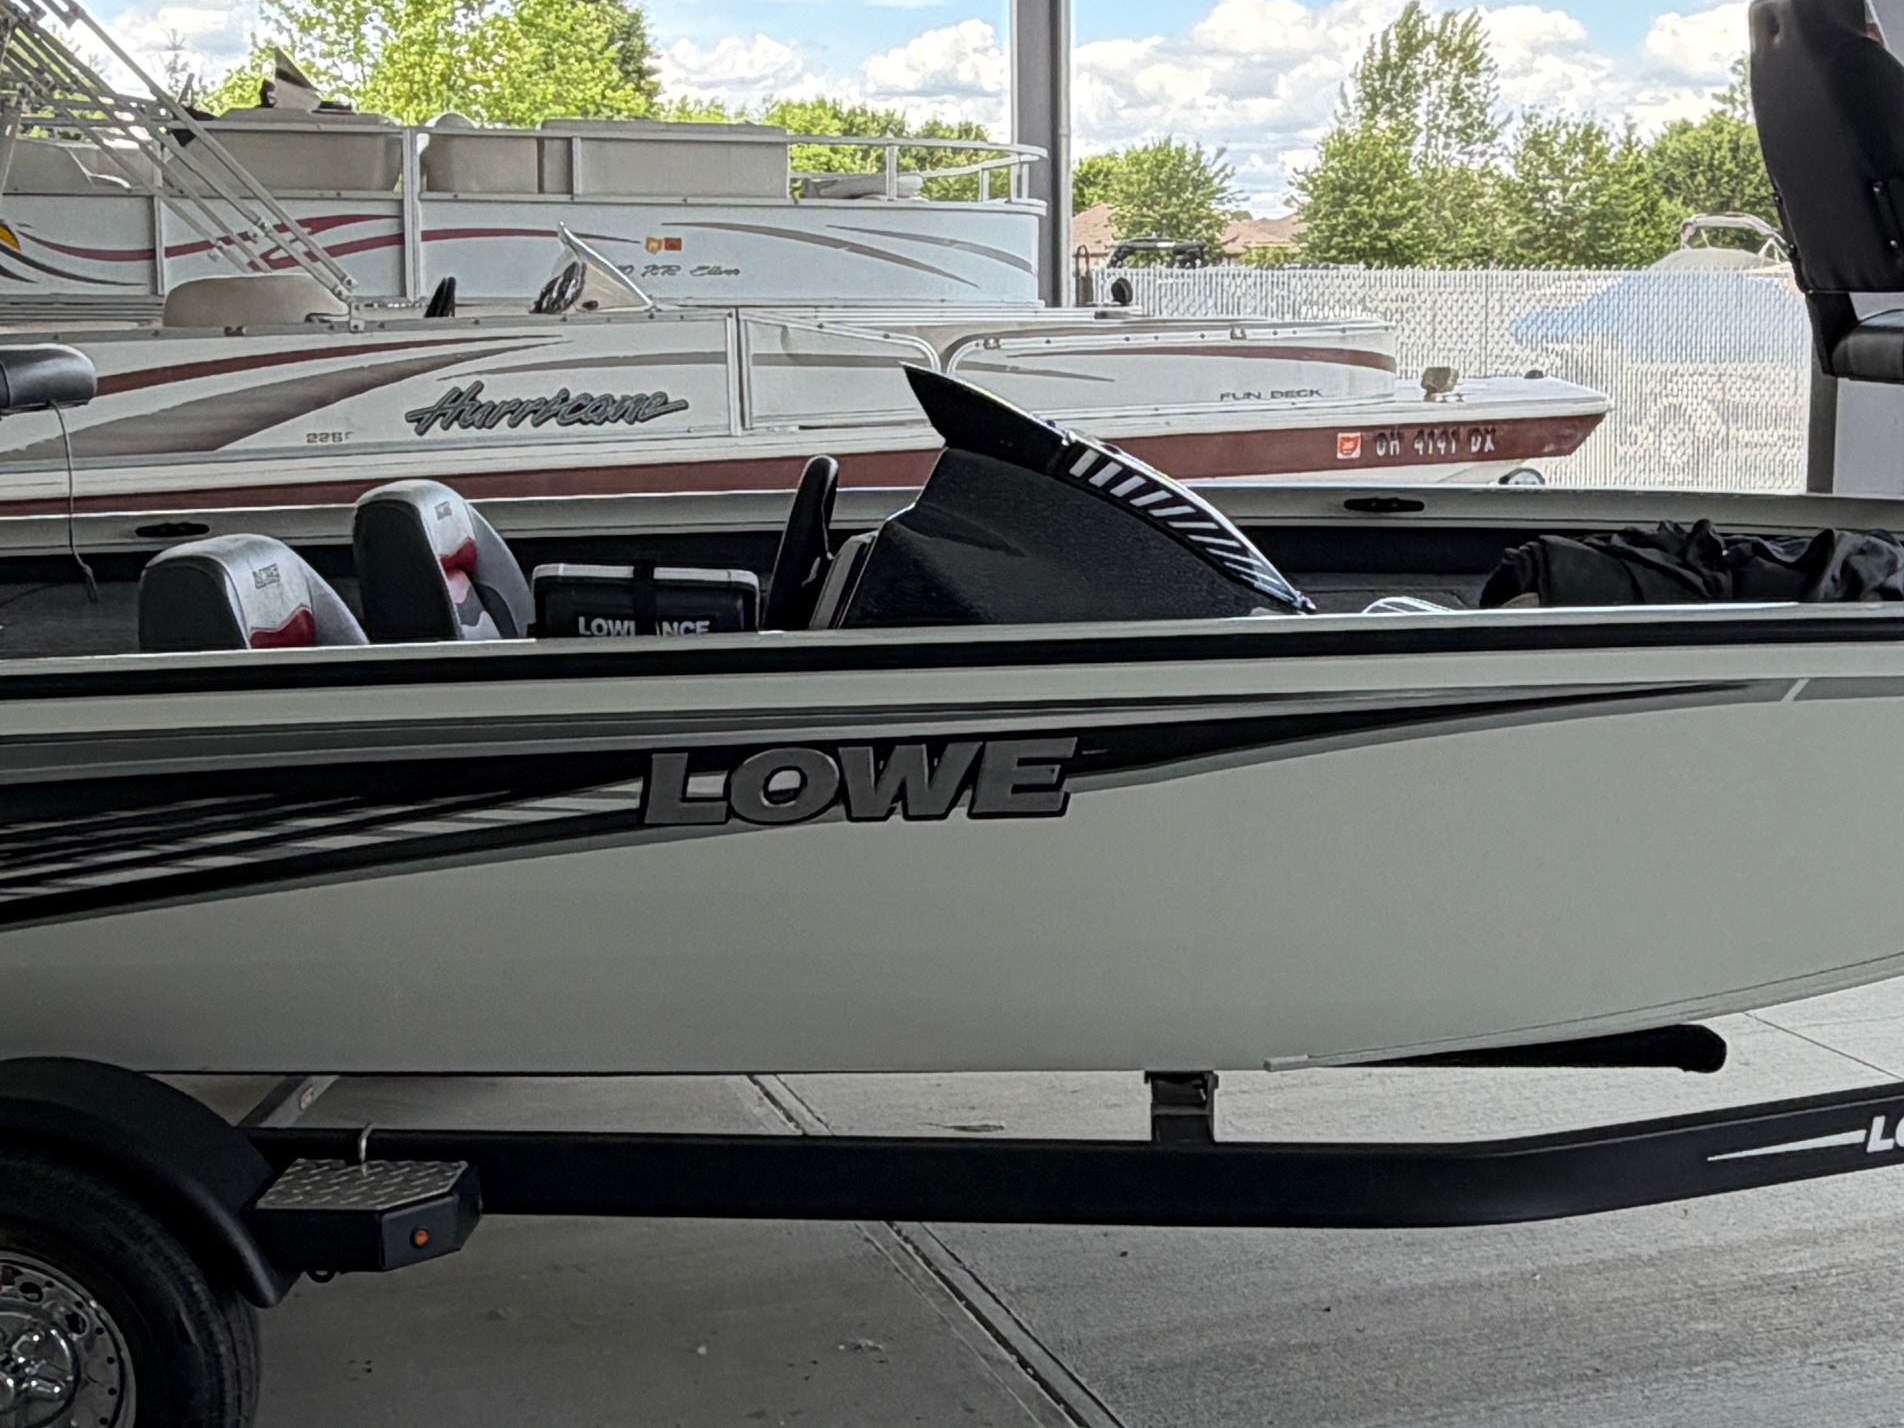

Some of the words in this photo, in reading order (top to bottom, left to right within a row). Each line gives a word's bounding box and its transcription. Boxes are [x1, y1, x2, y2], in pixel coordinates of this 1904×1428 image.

[404, 380, 689, 437] Hurricane
[1219, 392, 1262, 402] FUN
[1270, 389, 1323, 400] DECK
[577, 615, 712, 638] LOWNCE
[644, 735, 1079, 825] LOWE
